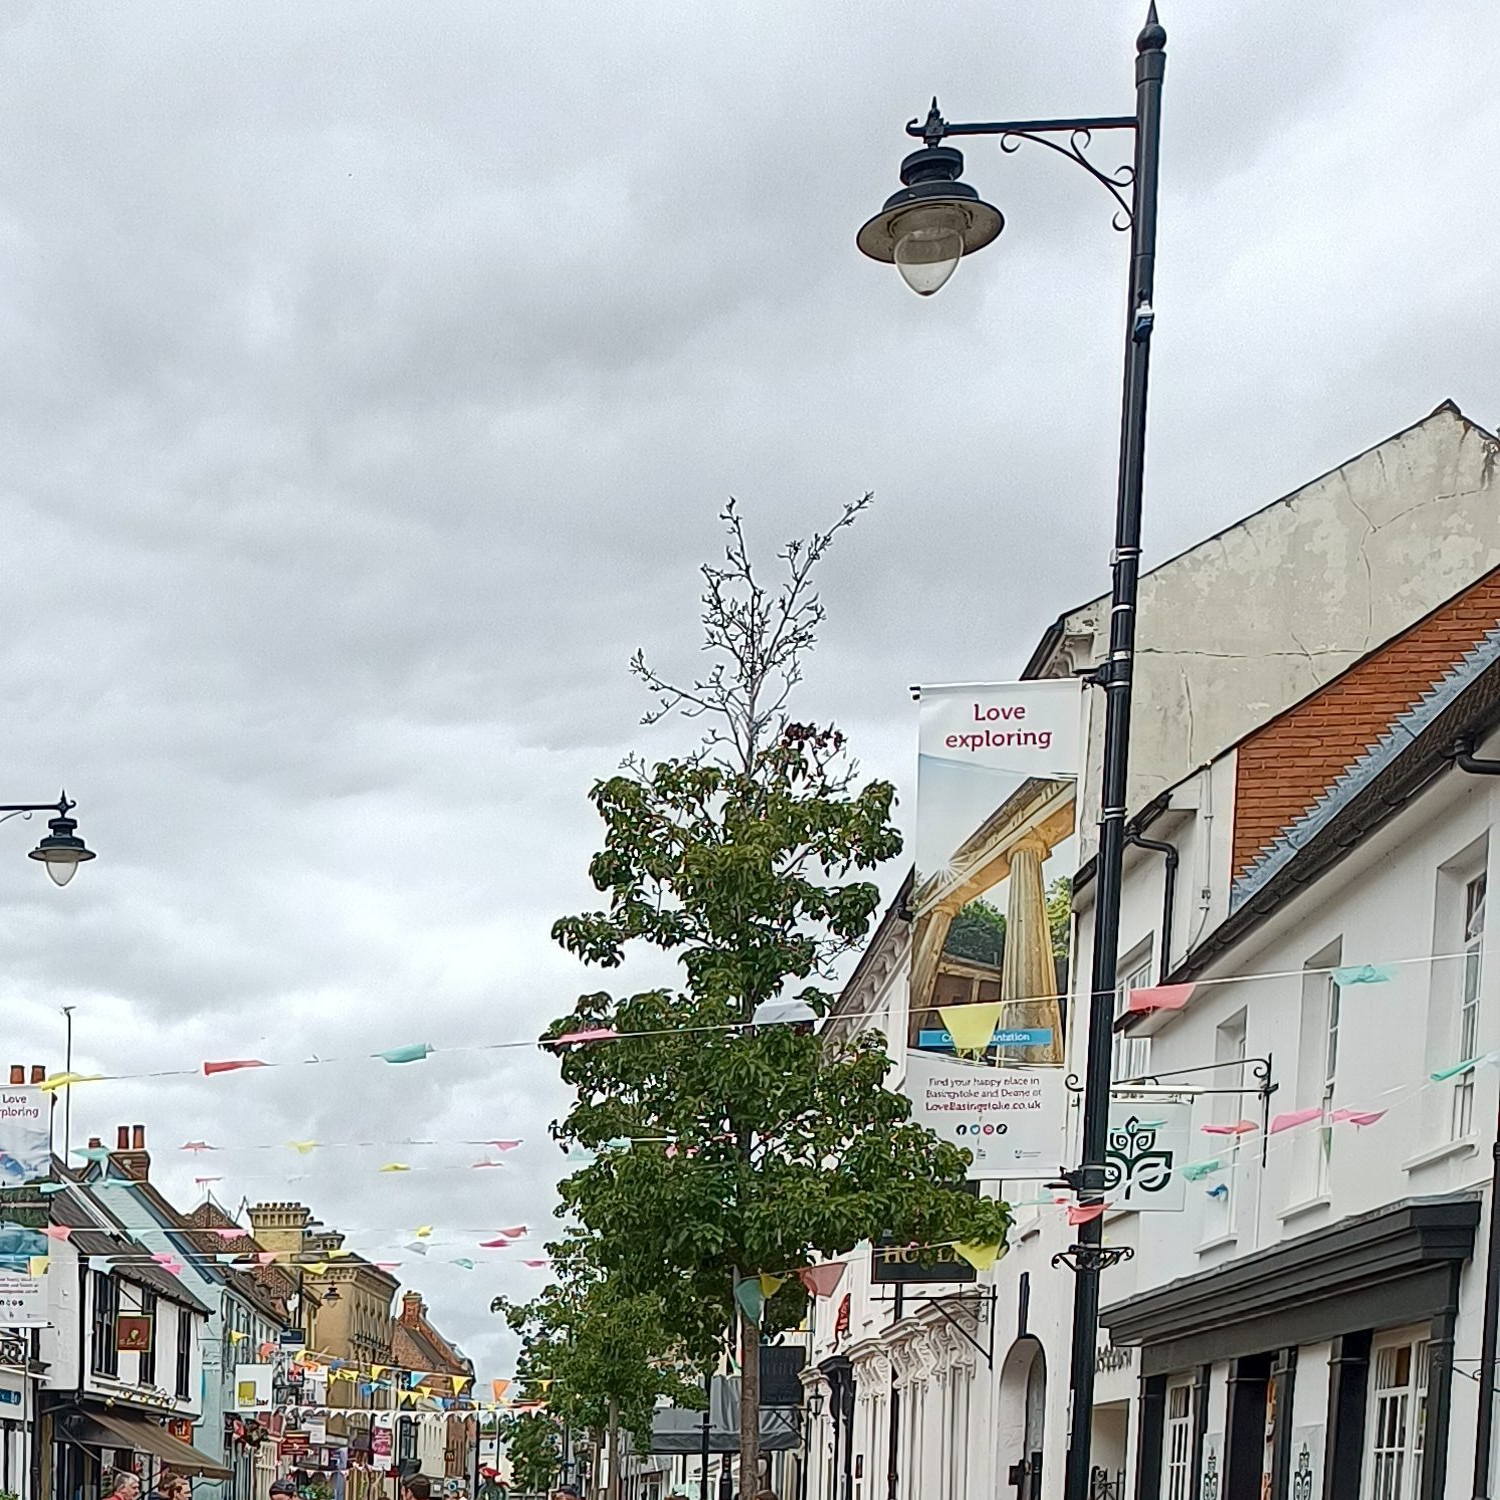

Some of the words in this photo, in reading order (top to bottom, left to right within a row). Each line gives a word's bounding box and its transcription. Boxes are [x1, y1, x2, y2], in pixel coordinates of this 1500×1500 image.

[973, 703, 1026, 721] Love
[945, 728, 1052, 752] exploring
[2, 1094, 27, 1104] Love
[981, 1089, 999, 1098] and
